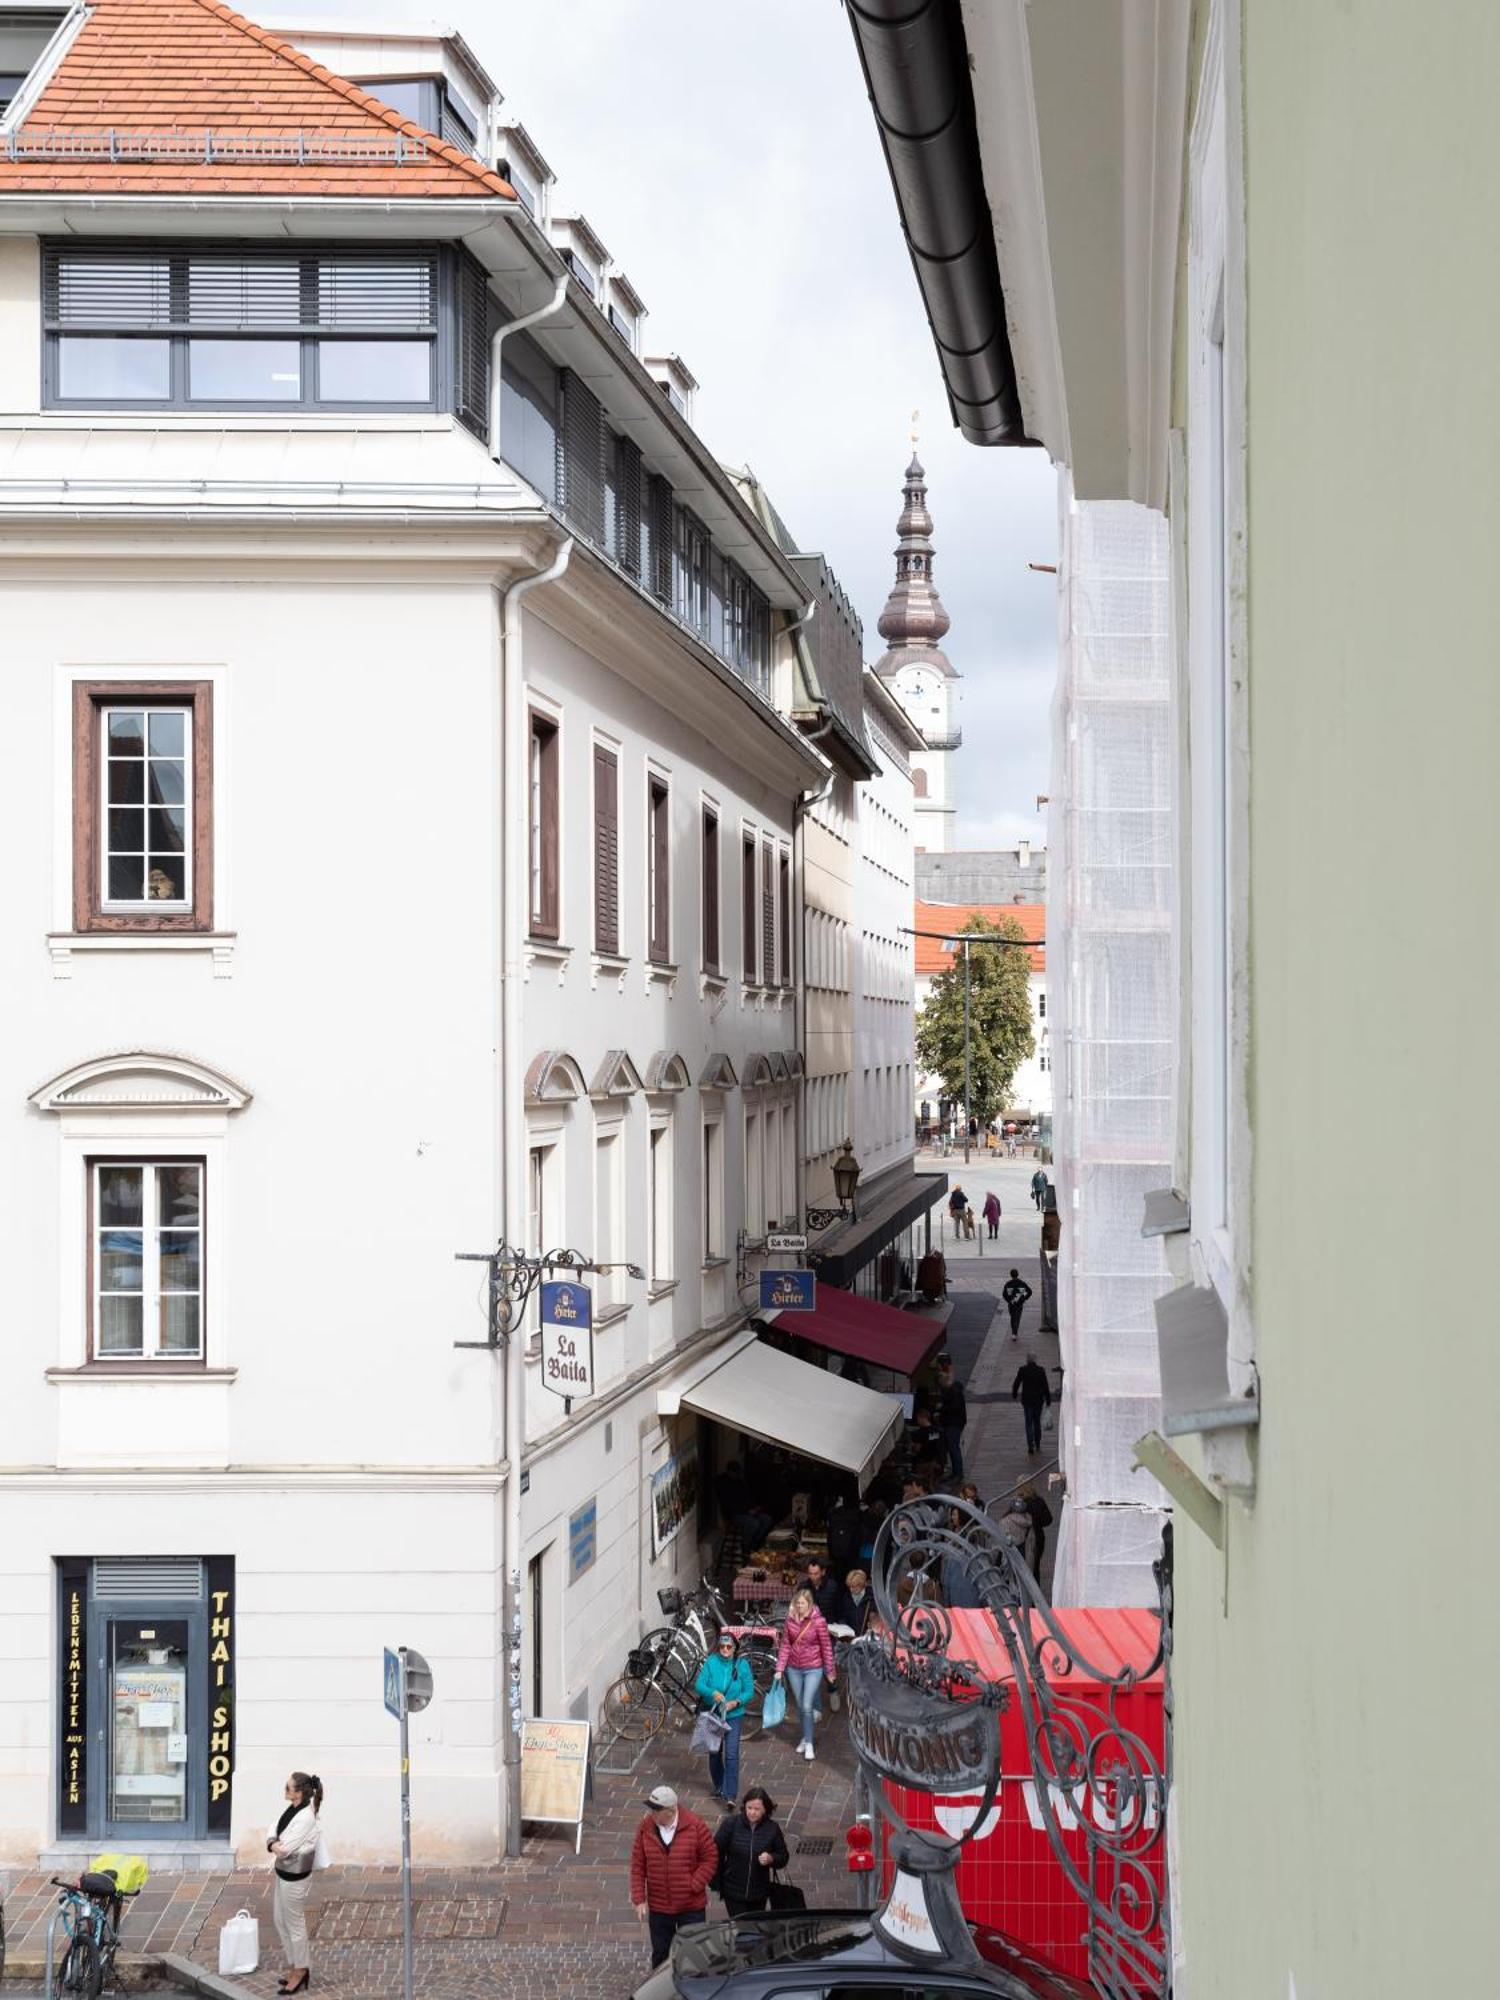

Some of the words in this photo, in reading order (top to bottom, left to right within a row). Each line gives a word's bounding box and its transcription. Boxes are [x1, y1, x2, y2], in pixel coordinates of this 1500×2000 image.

[770, 1239, 781, 1247] La
[772, 1291, 804, 1304] Hirter
[557, 1334, 576, 1357] La
[547, 1357, 587, 1382] Baita
[211, 1591, 230, 1686] THAI
[69, 1592, 81, 1727] LEBENSMITTEL
[66, 1735, 82, 1743] AUS
[209, 1707, 230, 1802] SHOP
[69, 1748, 79, 1803] ASIEN
